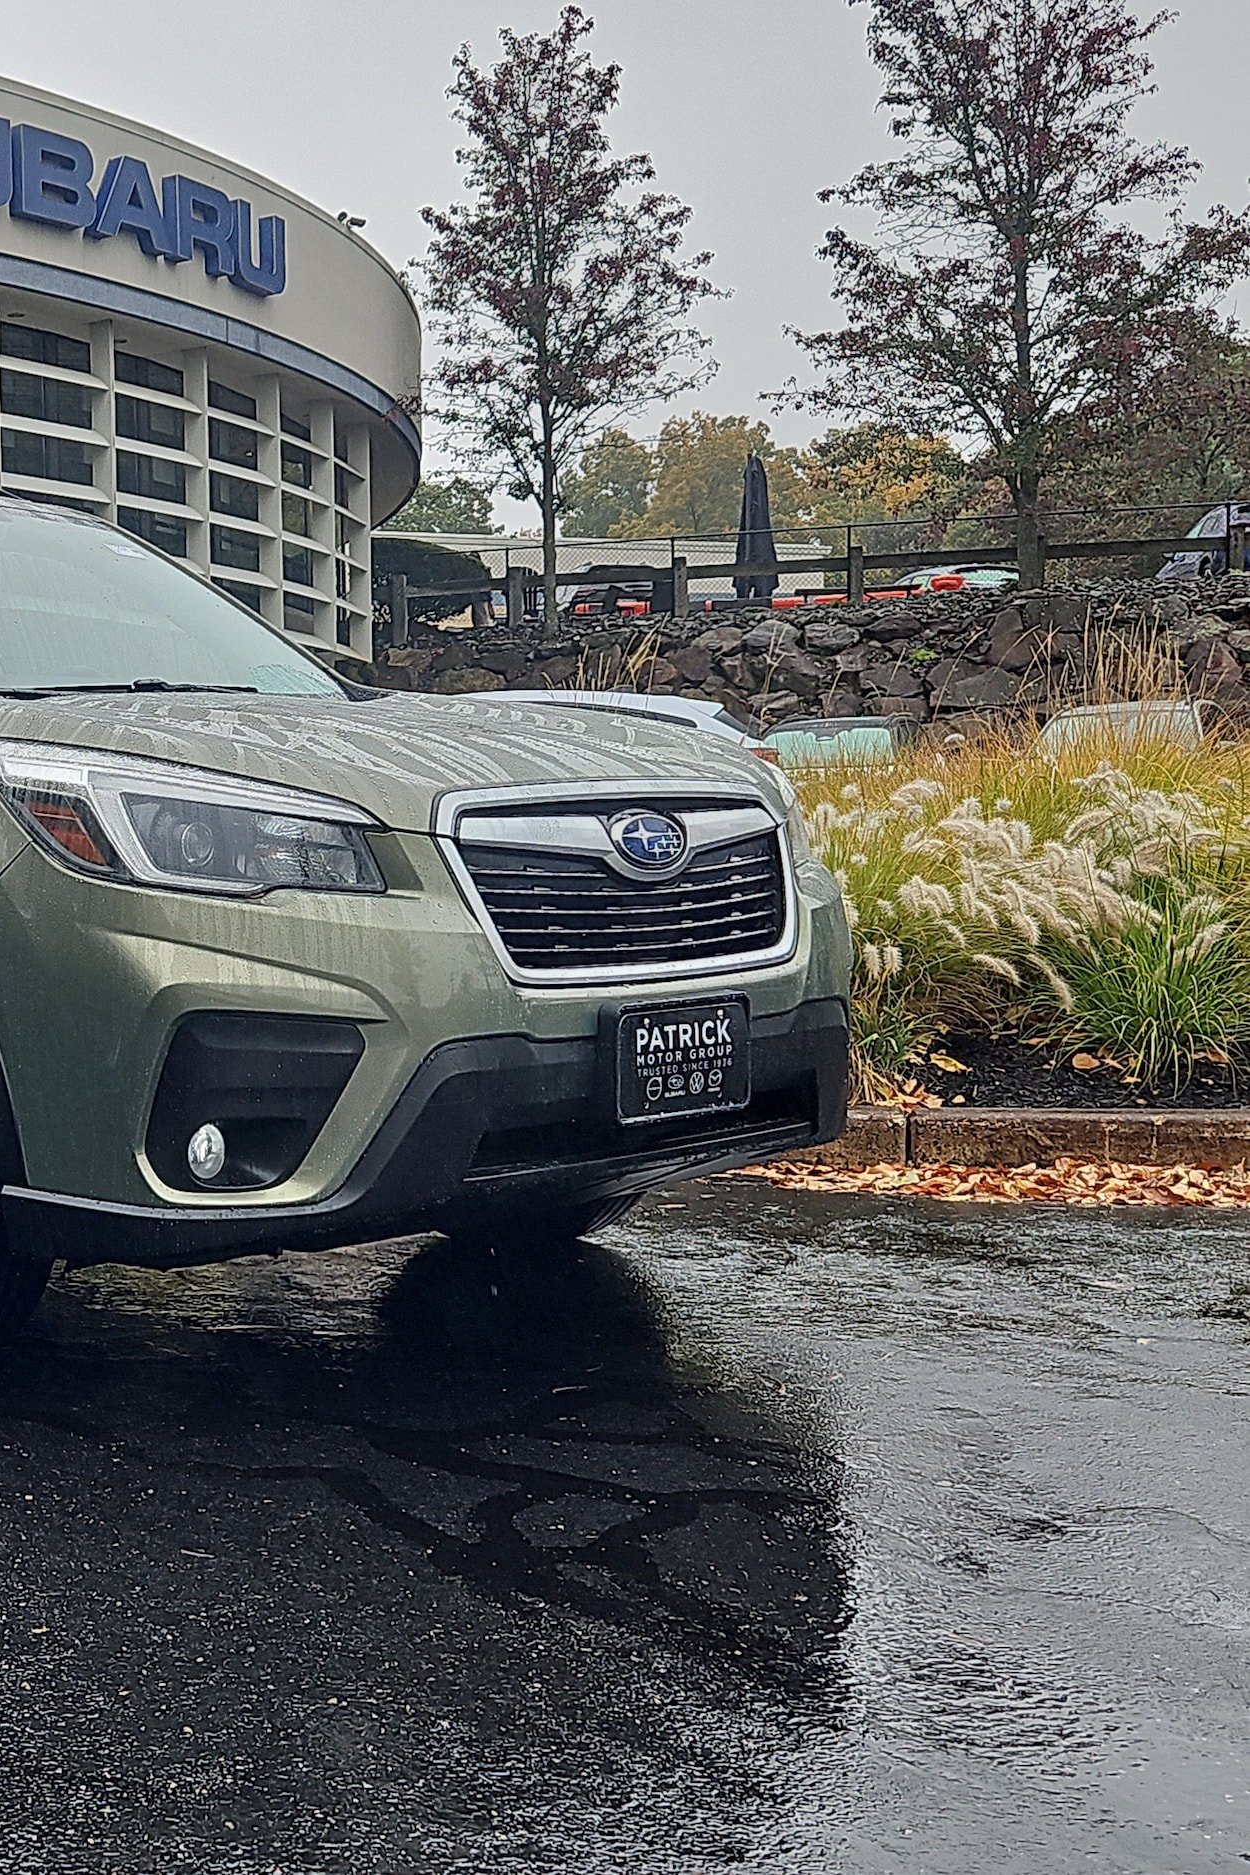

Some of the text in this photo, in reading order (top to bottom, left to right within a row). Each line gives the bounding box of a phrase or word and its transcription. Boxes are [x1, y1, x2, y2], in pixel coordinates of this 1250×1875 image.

[636, 1018, 732, 1053] PATRICK
[636, 1045, 733, 1067] MOTOR GROUP
[637, 1064, 679, 1078] TRUSTED
[682, 1060, 710, 1072] SINCE
